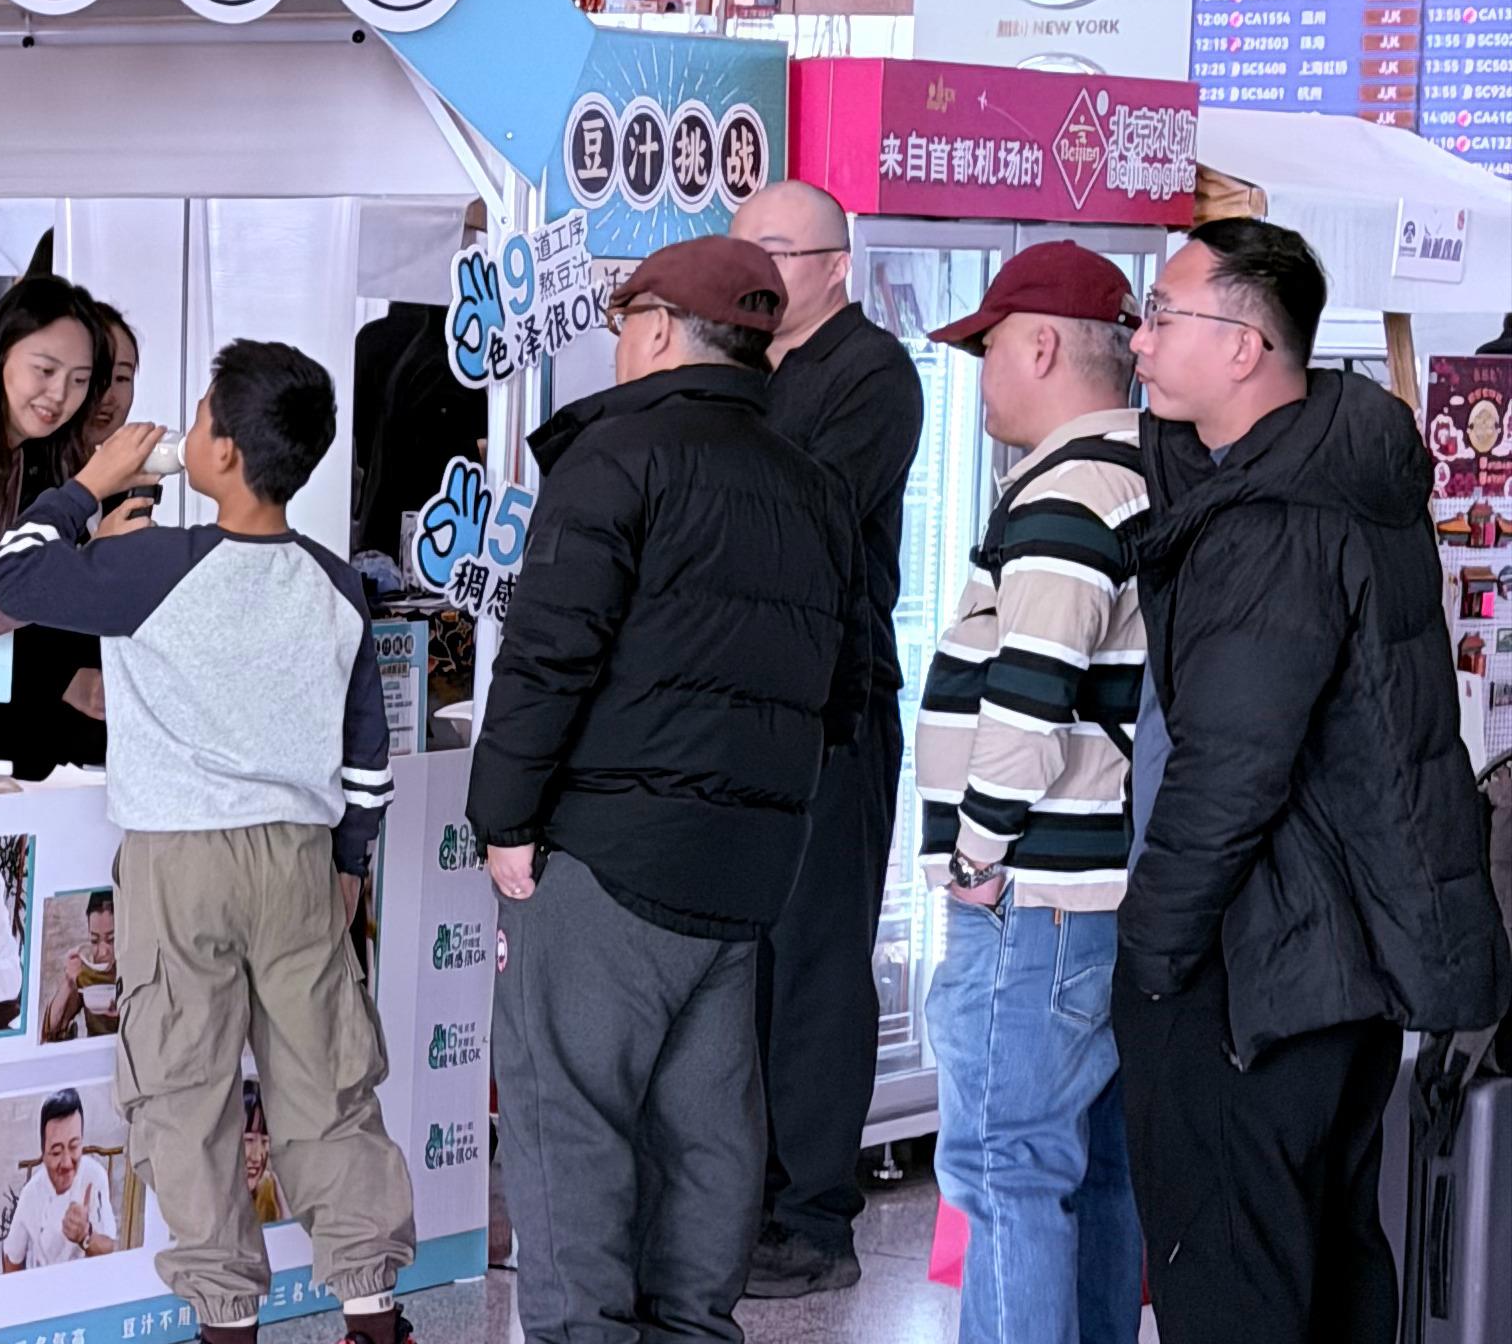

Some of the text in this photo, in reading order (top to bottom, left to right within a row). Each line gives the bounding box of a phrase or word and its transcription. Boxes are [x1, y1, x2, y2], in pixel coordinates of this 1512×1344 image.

[1032, 20, 1071, 36] NEW
[1075, 19, 1120, 35] YORK
[577, 117, 758, 190] 豆汁挑战
[879, 130, 1043, 188] 来自首都机场的
[1108, 105, 1199, 160] 北京礼物
[533, 216, 584, 263] 道工序
[503, 234, 534, 315] 9
[539, 251, 592, 302] 熬豆汁
[488, 284, 610, 380] 色泽很OK
[488, 487, 533, 566] 5
